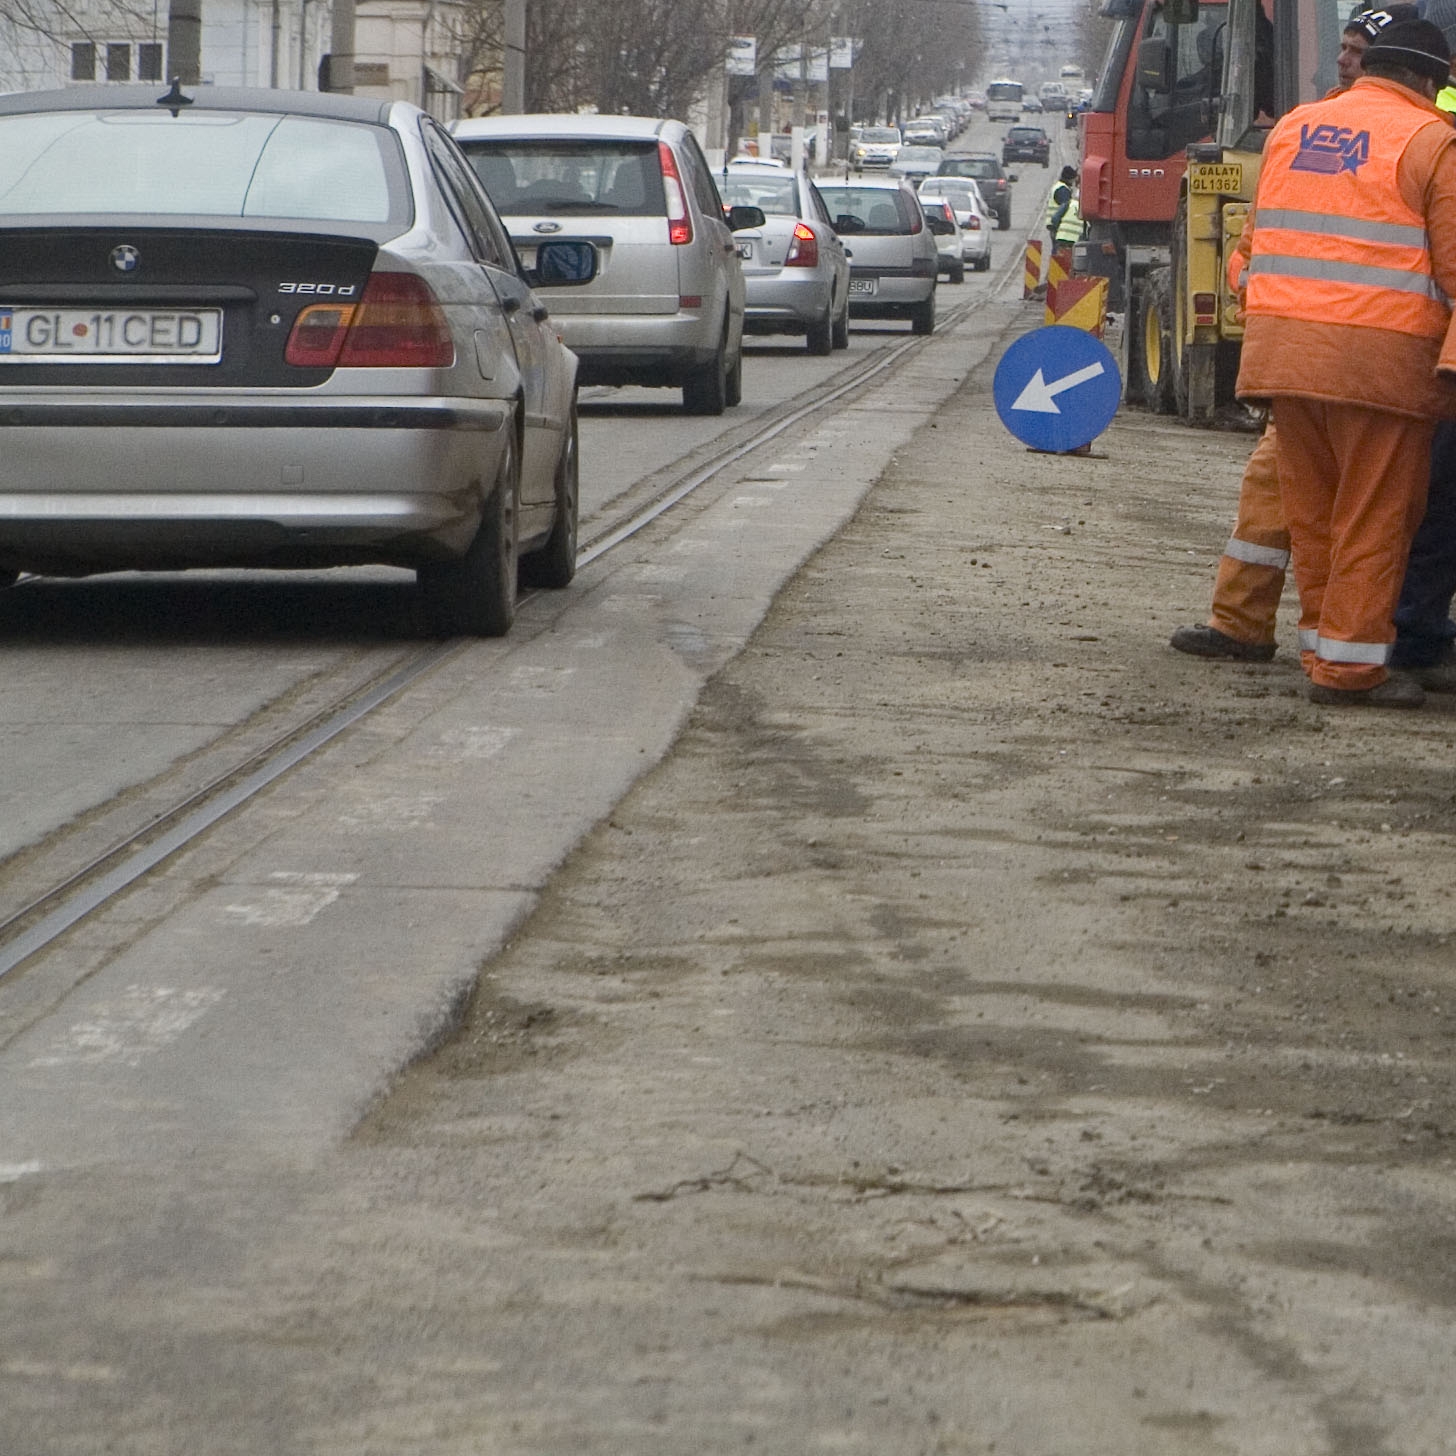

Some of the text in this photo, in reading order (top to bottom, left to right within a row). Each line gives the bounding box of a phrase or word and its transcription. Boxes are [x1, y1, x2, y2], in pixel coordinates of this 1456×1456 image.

[1300, 124, 1370, 160] VEGA
[1200, 167, 1240, 176] GALATI
[278, 283, 355, 296] 320d
